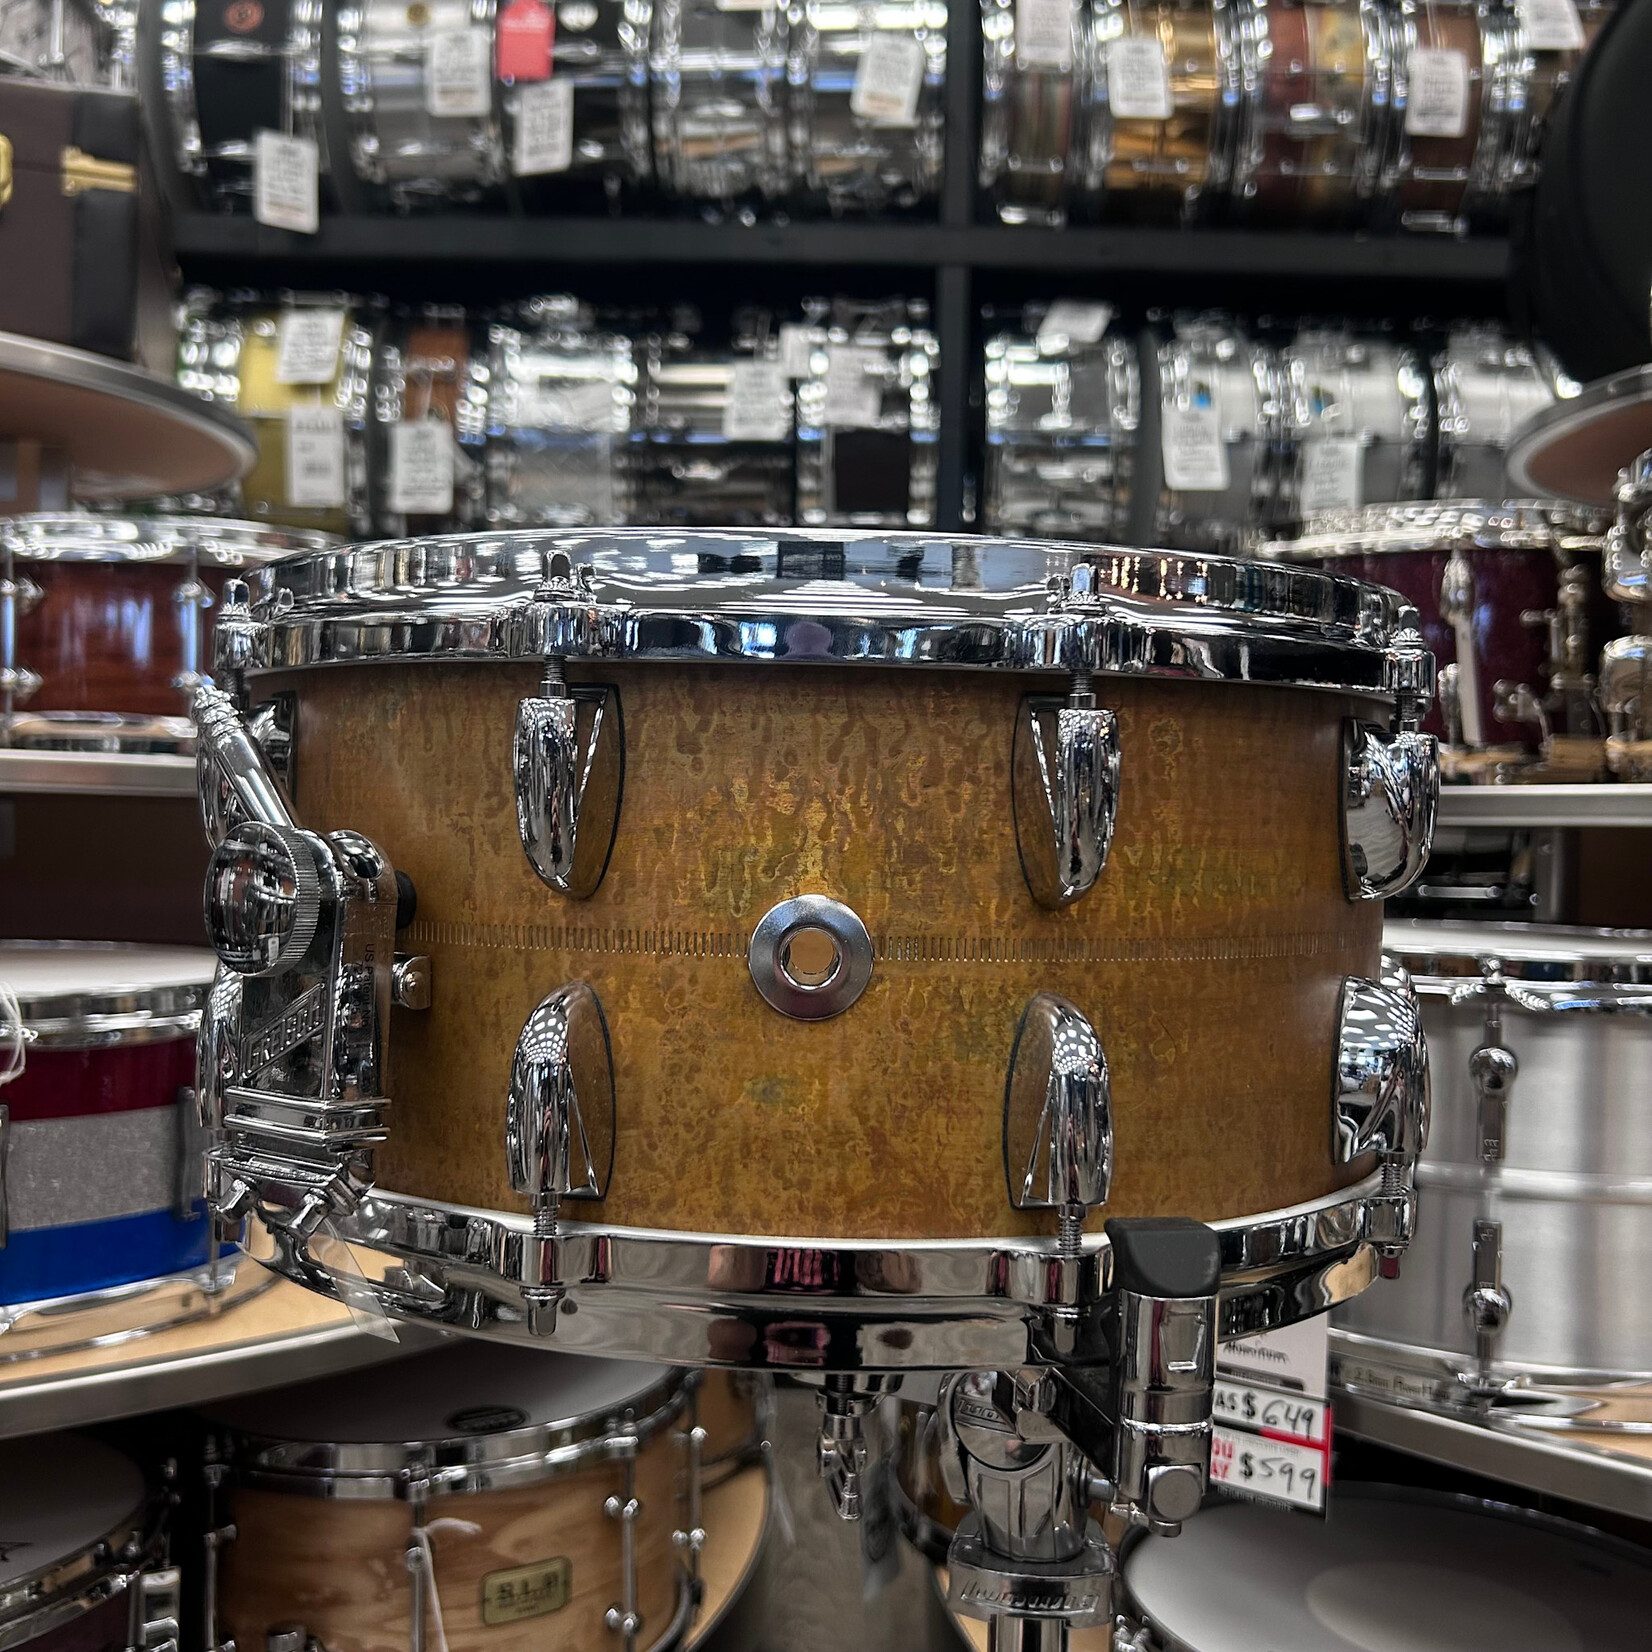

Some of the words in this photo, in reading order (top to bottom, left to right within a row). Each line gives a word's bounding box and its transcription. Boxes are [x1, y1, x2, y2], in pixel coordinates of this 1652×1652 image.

[364, 943, 375, 962] US
[363, 966, 374, 1008] Patent
[1214, 1390, 1237, 1411] AS
[1242, 1390, 1314, 1441] $649
[1212, 1437, 1234, 1460] OU
[1210, 1460, 1229, 1480] AY
[1240, 1452, 1317, 1501] $599
